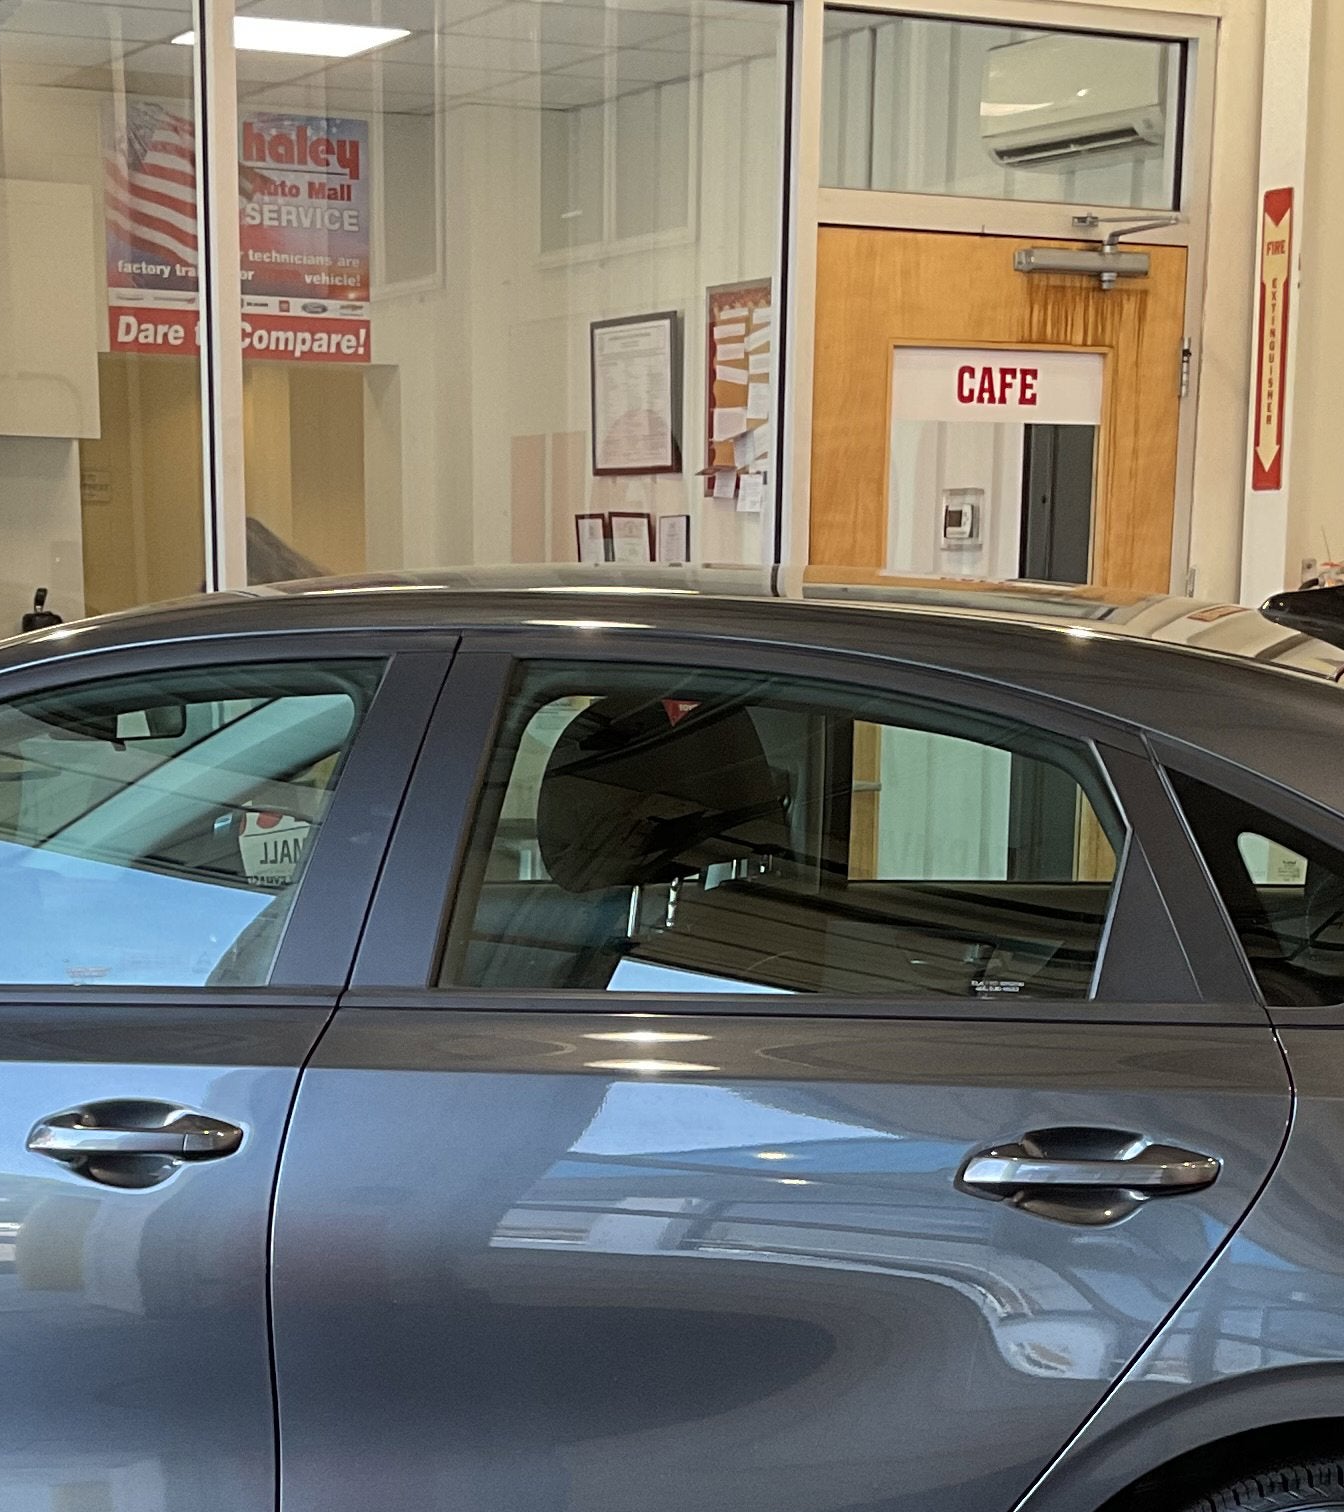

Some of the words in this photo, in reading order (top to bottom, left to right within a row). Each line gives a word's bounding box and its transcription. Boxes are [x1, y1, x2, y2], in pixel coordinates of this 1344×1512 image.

[242, 120, 360, 181] haley
[252, 178, 301, 198] Auto
[307, 181, 353, 203] Mall
[244, 202, 360, 233] SERVICE
[248, 249, 333, 267] technicians
[336, 257, 361, 268] are
[1266, 239, 1286, 256] FIRE
[117, 259, 171, 278] factory
[304, 271, 362, 288] vehicle!
[117, 315, 185, 346] Dare
[240, 321, 367, 358] Compare!
[1265, 277, 1279, 425] EXTINGUISHER
[957, 365, 1038, 406] CAFE
